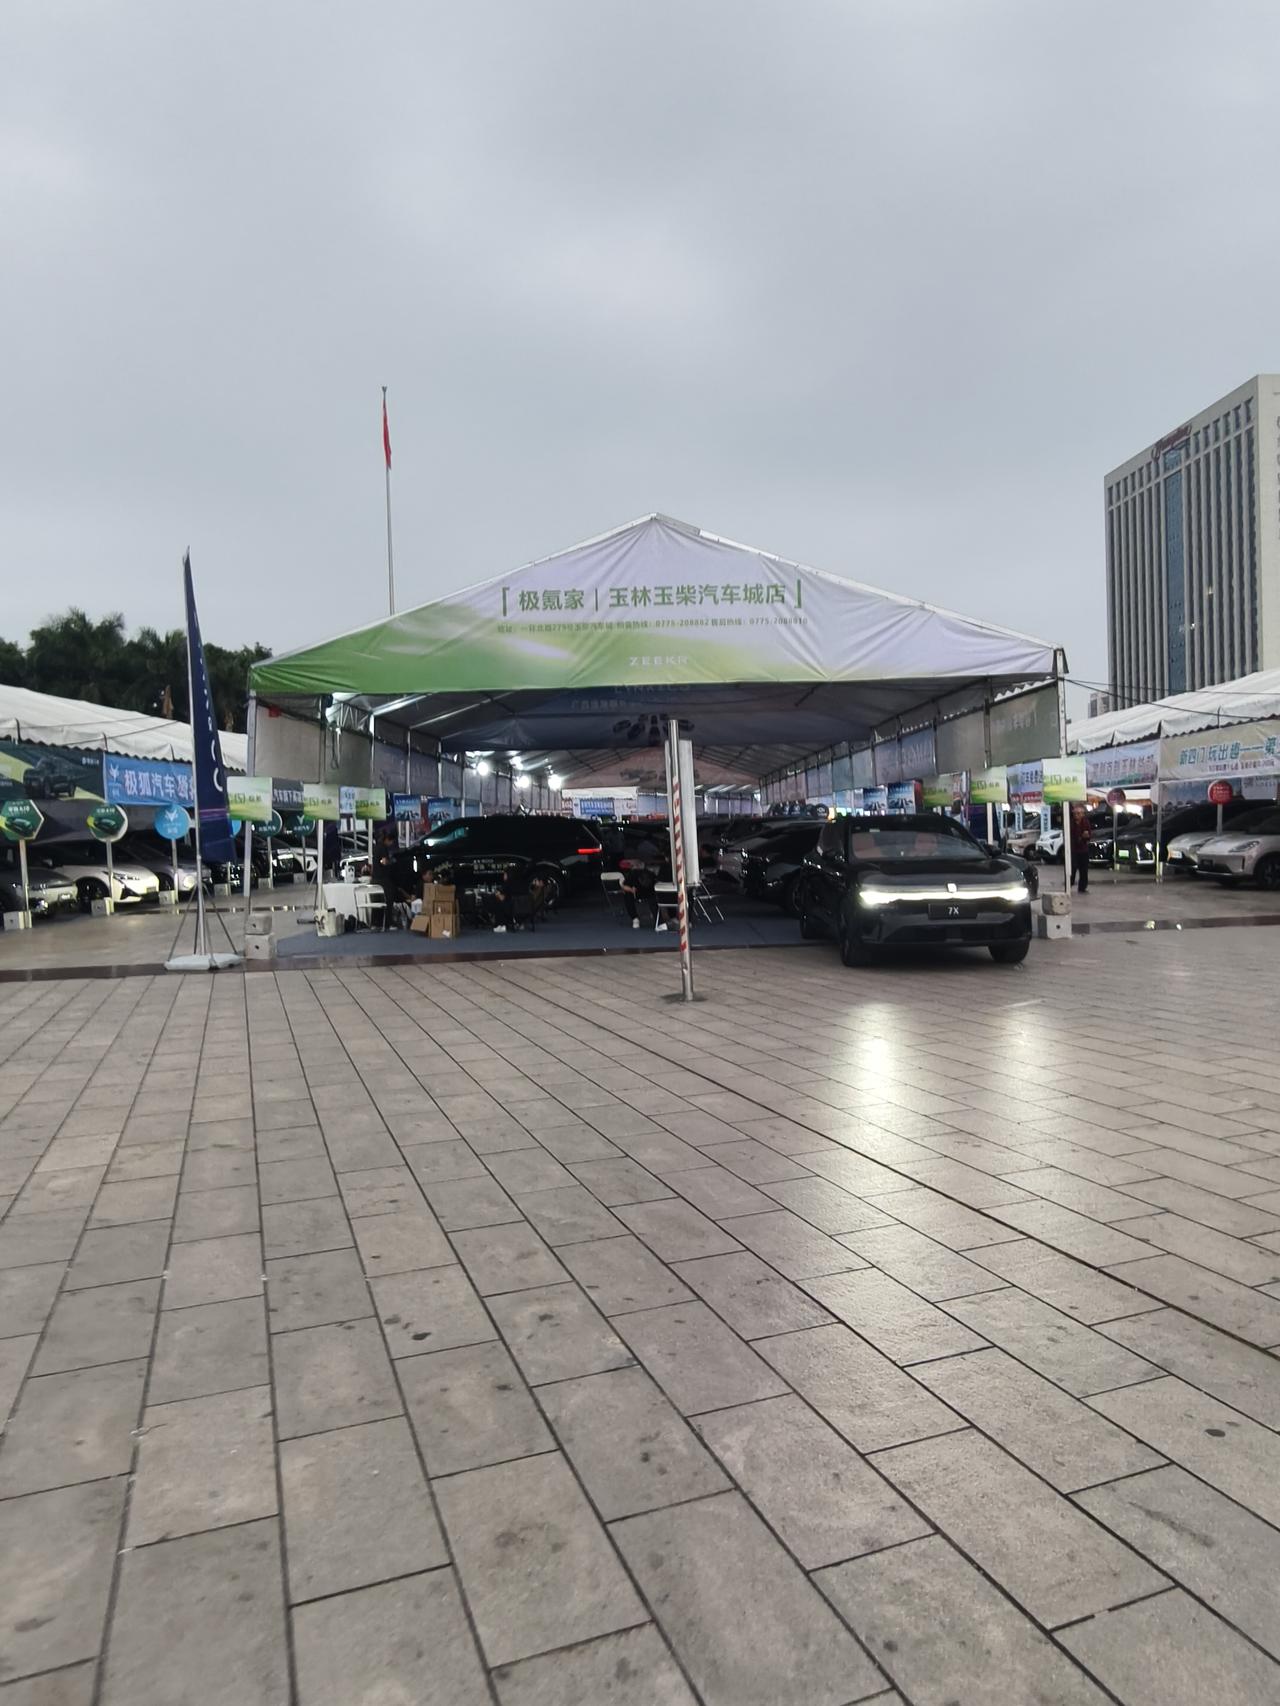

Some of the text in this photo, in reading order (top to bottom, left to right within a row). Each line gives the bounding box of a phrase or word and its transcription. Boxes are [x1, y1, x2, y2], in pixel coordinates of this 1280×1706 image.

[519, 584, 786, 611] 极氪家 玉林玉柴汽车城店
[629, 655, 688, 667] ZEEKR
[947, 906, 959, 915] 7X
